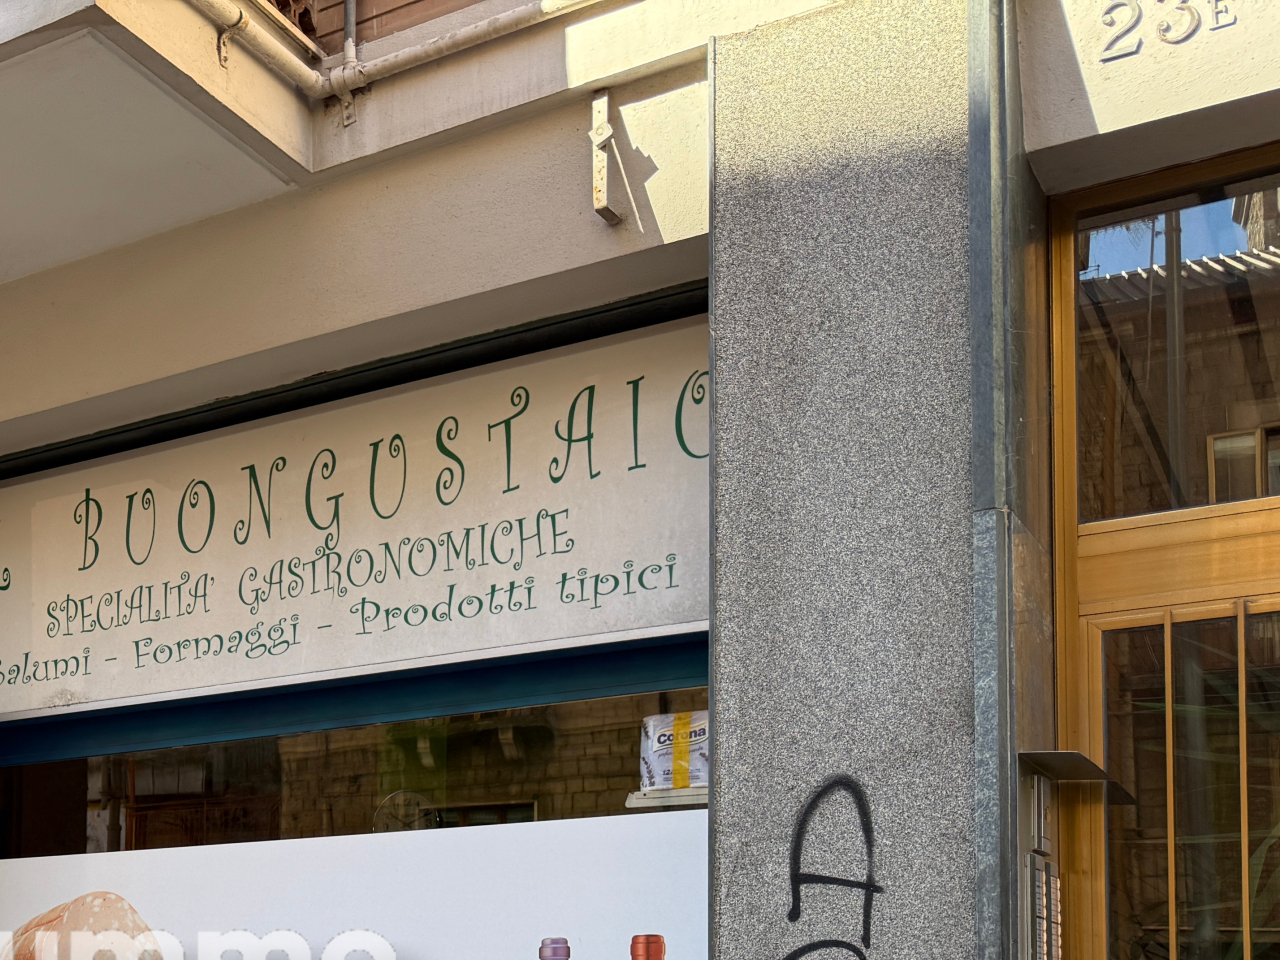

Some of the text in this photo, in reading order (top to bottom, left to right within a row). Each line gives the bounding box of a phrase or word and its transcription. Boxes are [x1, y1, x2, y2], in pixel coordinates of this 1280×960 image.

[1099, 0, 1238, 64] 23E
[73, 368, 709, 572] BUONGUSTAIO
[133, 614, 301, 669] Formaggi
[350, 577, 536, 636] Prodotti
[556, 553, 678, 609] tipici
[238, 508, 575, 615] GASTRONOMICHE
